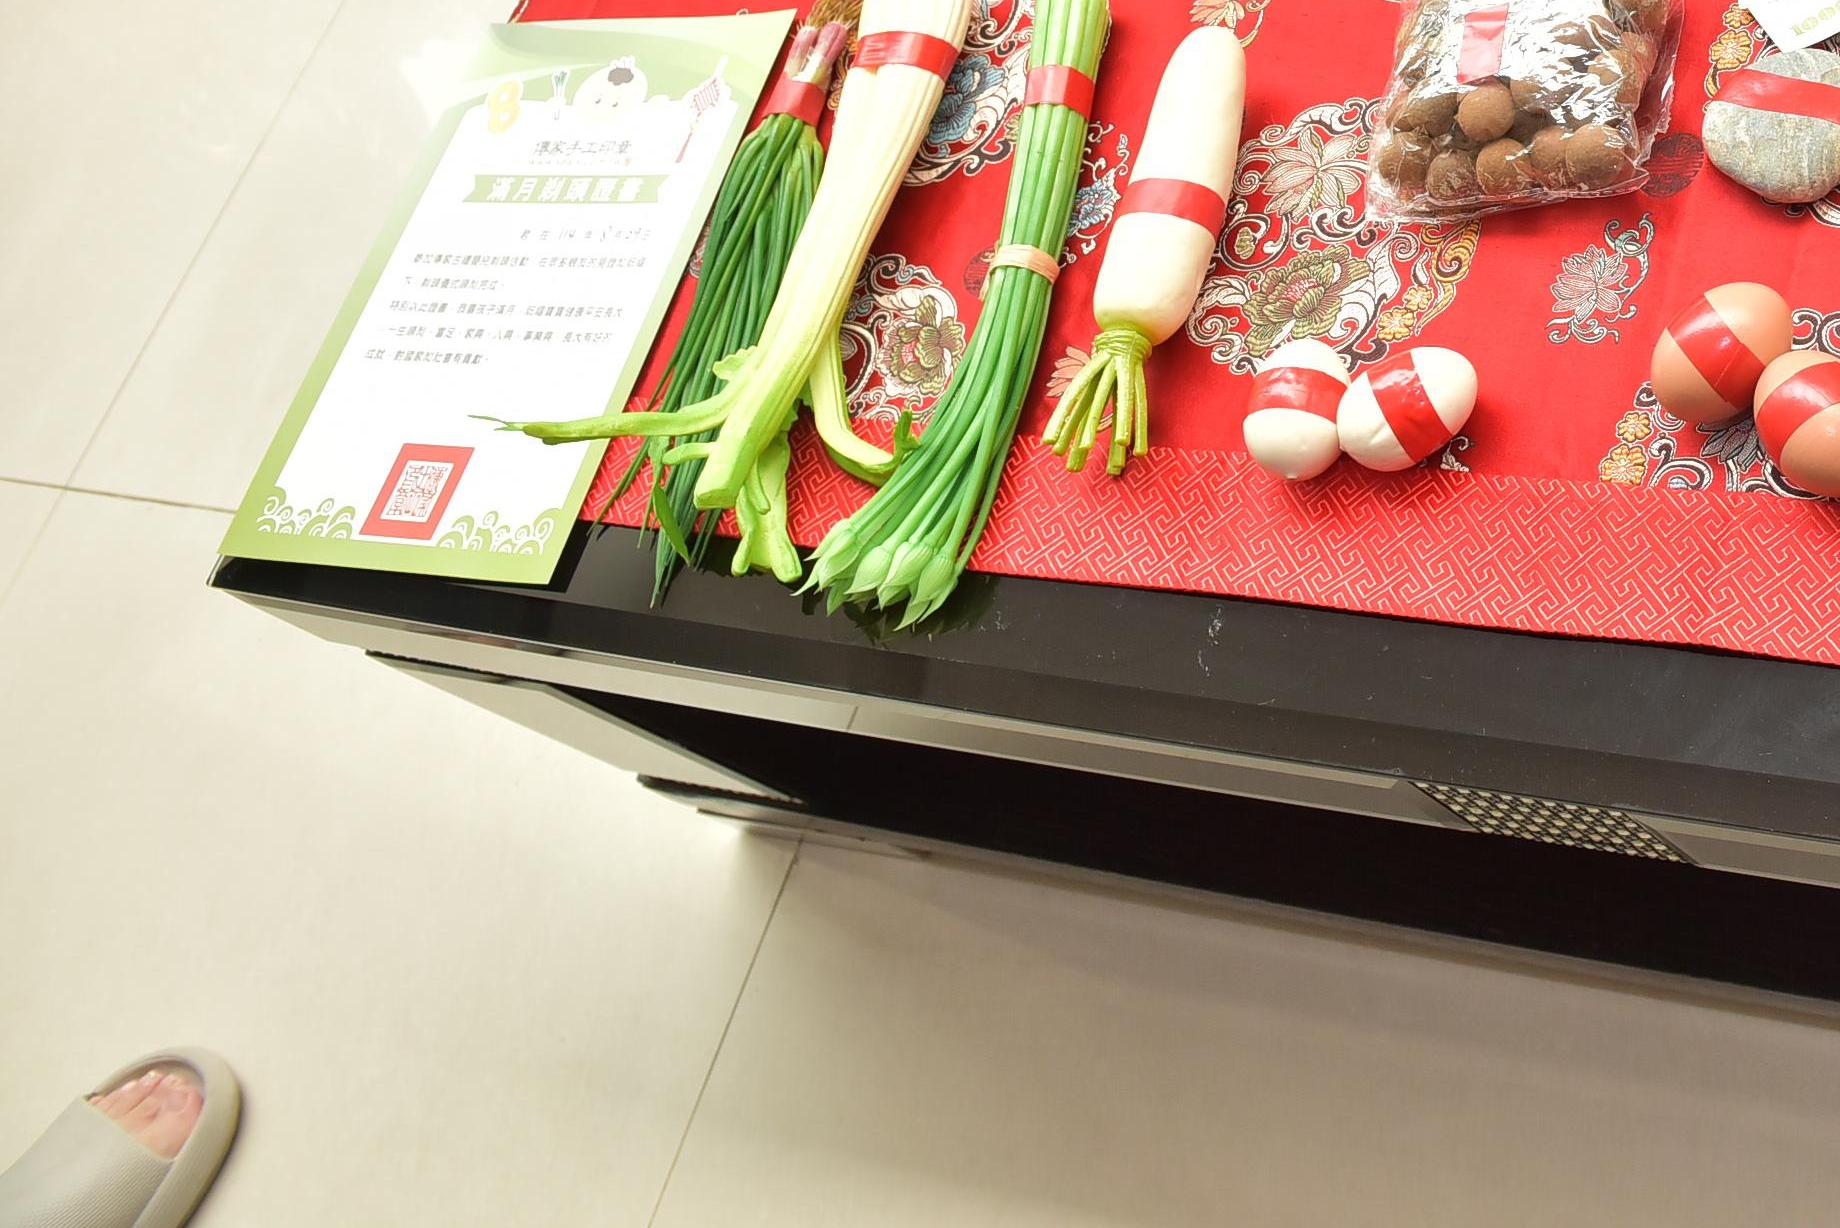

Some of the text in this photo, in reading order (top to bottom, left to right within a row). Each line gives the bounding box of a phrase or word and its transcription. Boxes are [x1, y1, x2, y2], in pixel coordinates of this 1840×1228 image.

[534, 139, 632, 156] 傳家手工印章
[487, 176, 645, 202] 滿月剃頭證書
